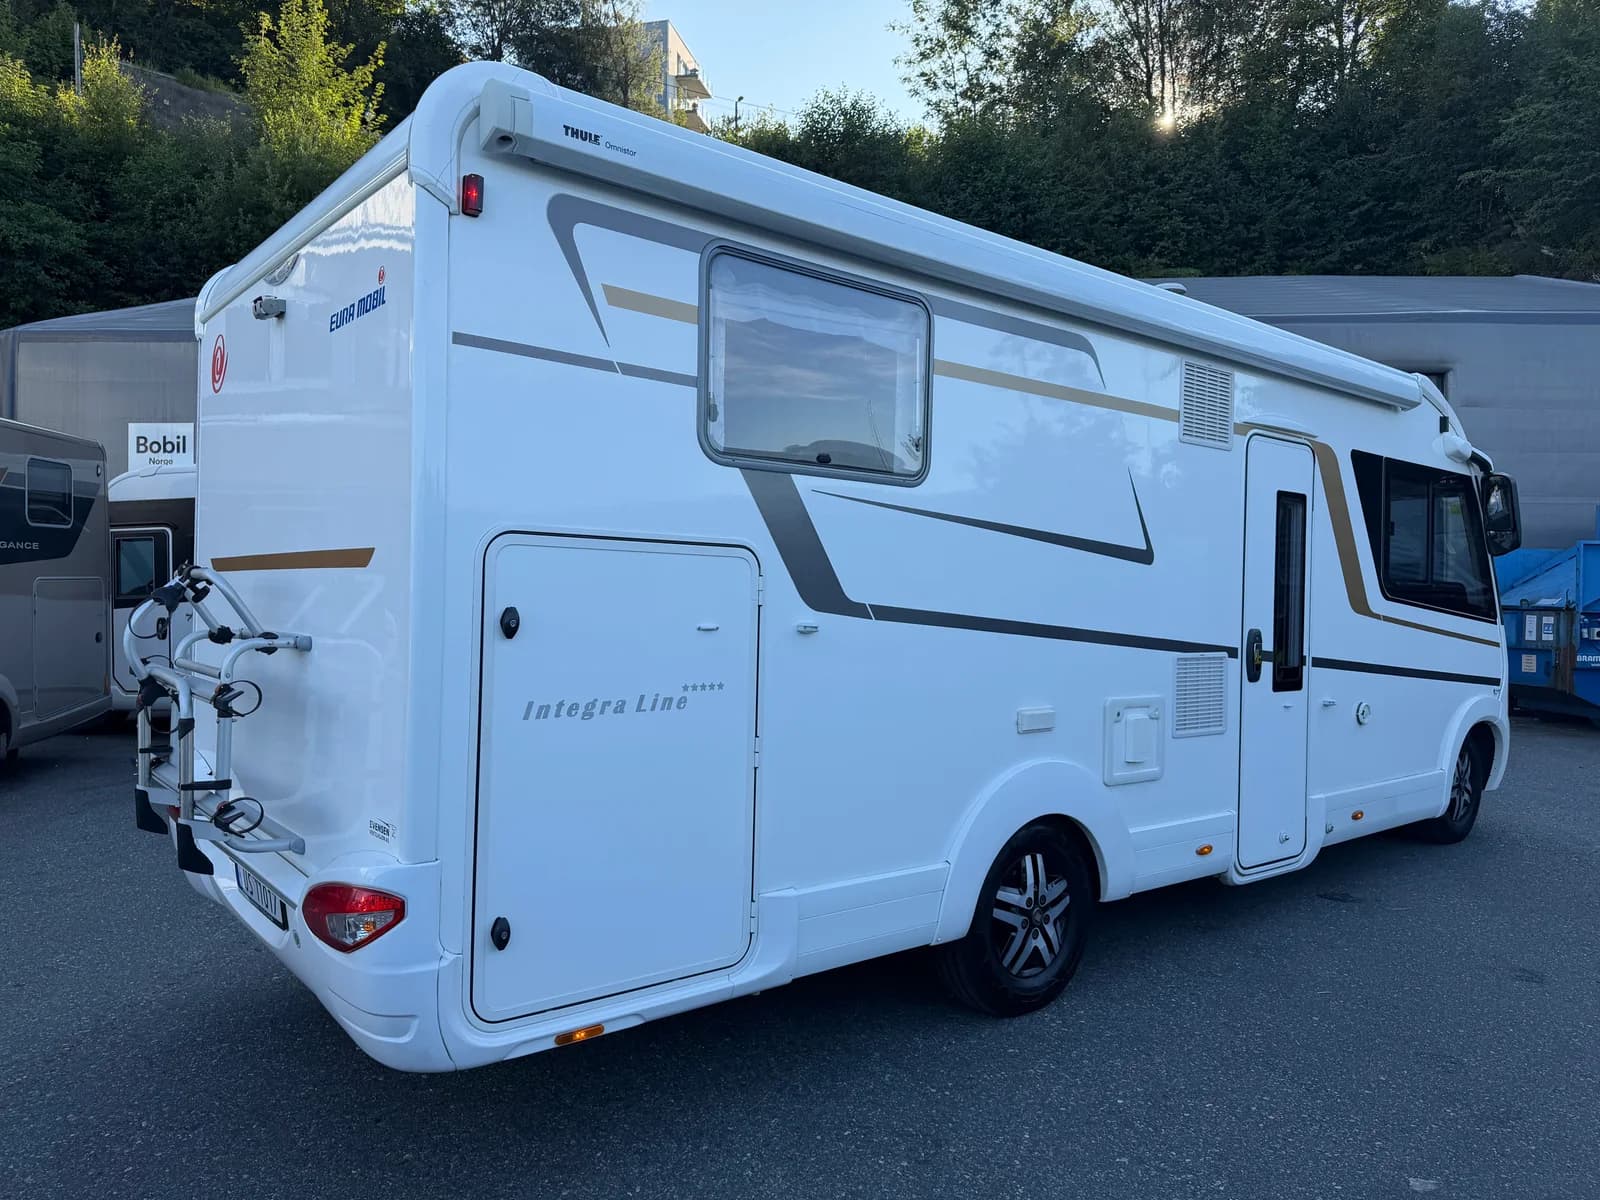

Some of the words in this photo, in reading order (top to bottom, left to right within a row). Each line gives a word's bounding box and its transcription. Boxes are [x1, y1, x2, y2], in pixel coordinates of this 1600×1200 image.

[563, 124, 601, 146] THULE
[605, 141, 637, 156] Omnistor
[329, 302, 356, 333] EURA
[356, 285, 386, 318] MOBIL
[136, 435, 187, 454] Bobil
[522, 698, 627, 721] Integra
[635, 693, 688, 713] Line
